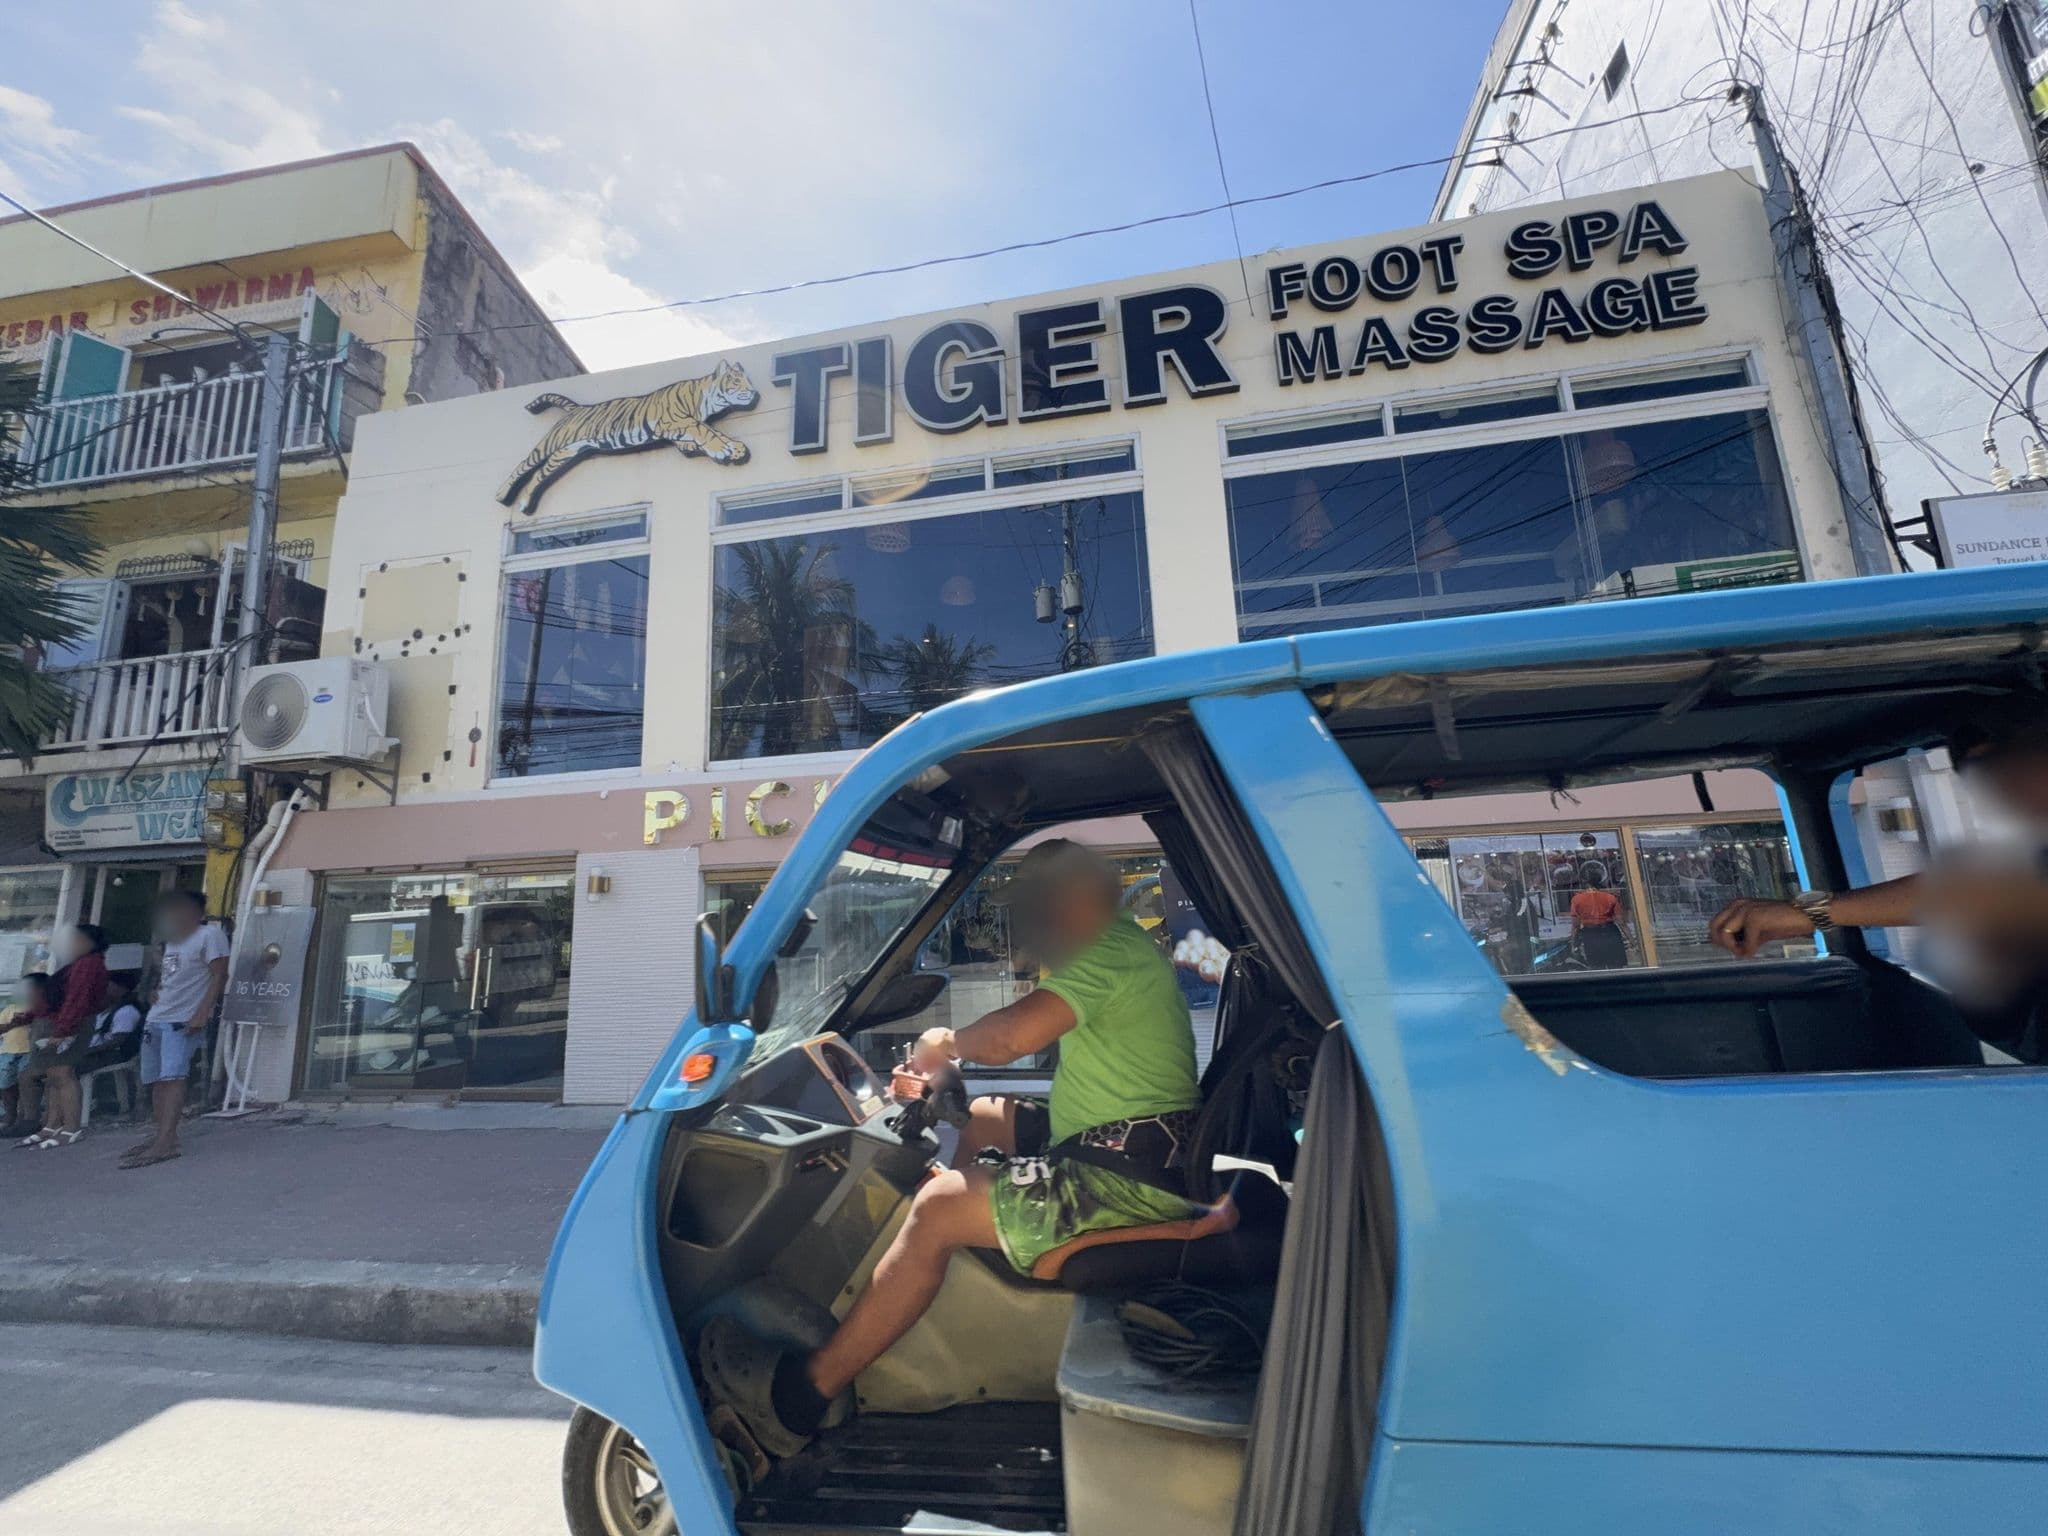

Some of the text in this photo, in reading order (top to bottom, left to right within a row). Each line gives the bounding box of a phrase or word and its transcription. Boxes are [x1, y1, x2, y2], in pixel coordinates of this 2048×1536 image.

[130, 266, 316, 326] SHAWARMA
[1265, 200, 1690, 321] FOOT SPA
[772, 283, 1241, 457] TIGER
[1273, 264, 1710, 387] MASSAGE
[1956, 537, 2042, 554] SUNDANCE
[251, 982, 292, 997] YEARS
